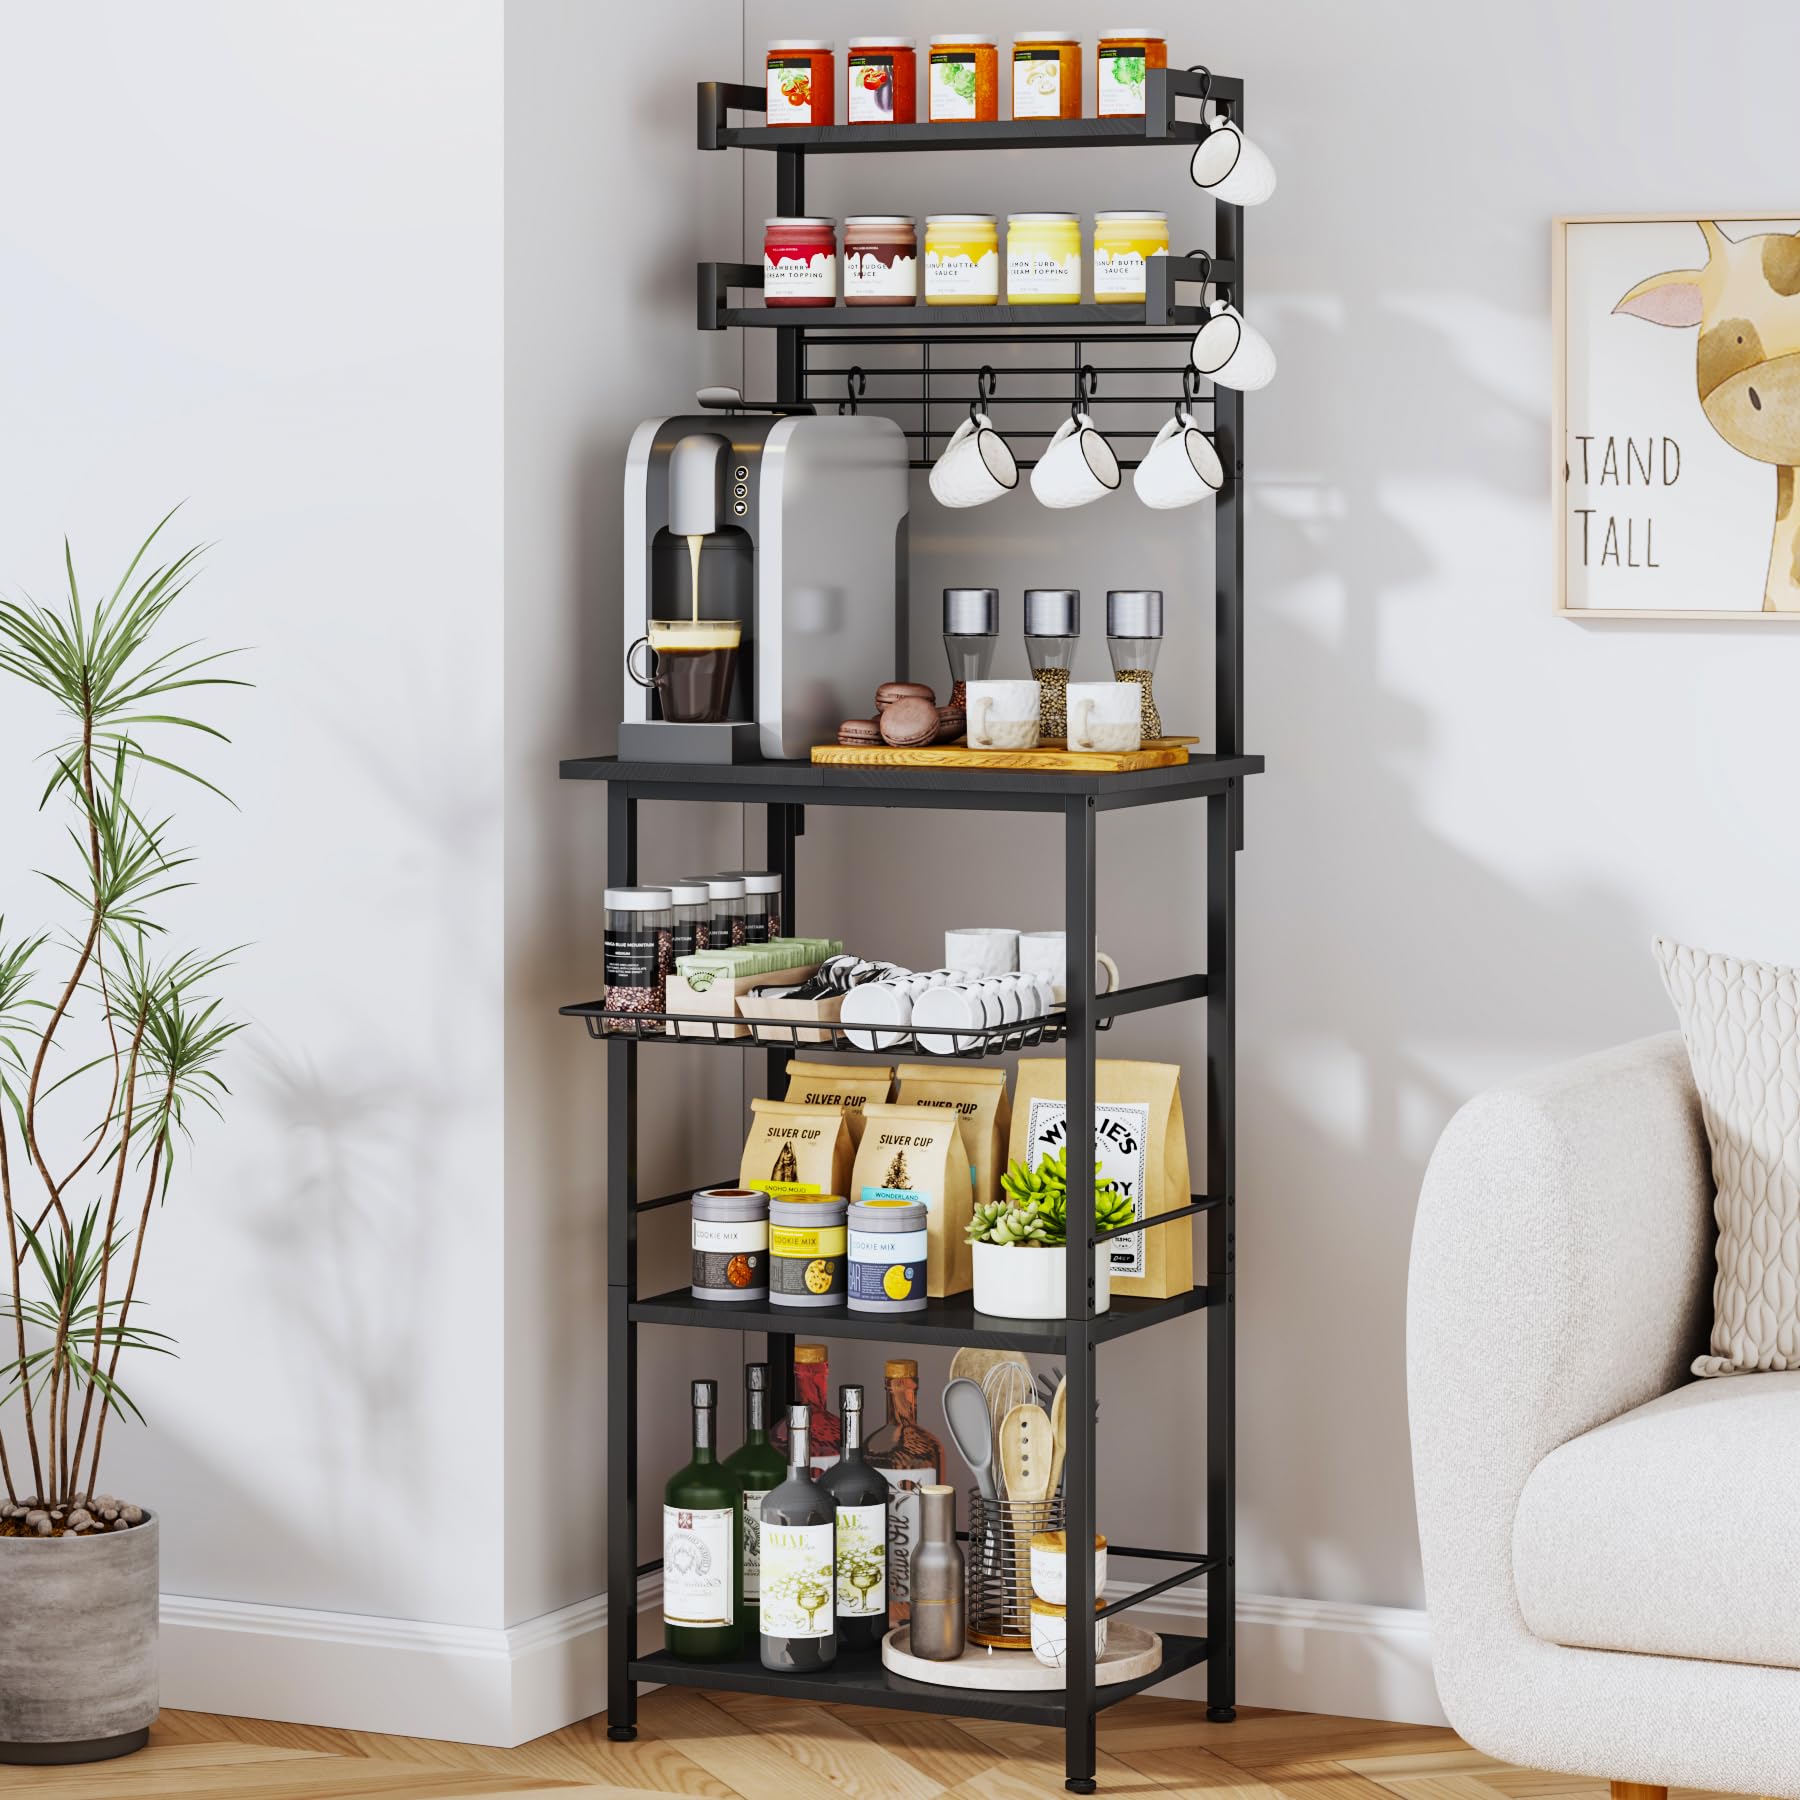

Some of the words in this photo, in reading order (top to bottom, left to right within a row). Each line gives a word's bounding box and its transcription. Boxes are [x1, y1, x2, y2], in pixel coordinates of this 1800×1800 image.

[1566, 436, 1681, 486] TAND
[1573, 509, 1660, 567] TALL
[805, 1093, 841, 1105] SILVER
[844, 1095, 867, 1107] CUP
[956, 1102, 978, 1114] CUP
[767, 1127, 799, 1138] SILVER
[801, 1129, 821, 1140] CUP
[879, 1134, 911, 1146] SILVER
[913, 1137, 934, 1147] CUP
[875, 1191, 919, 1201] WONDERLAND
[696, 1231, 721, 1240] COOKIE
[723, 1232, 738, 1240] MIX
